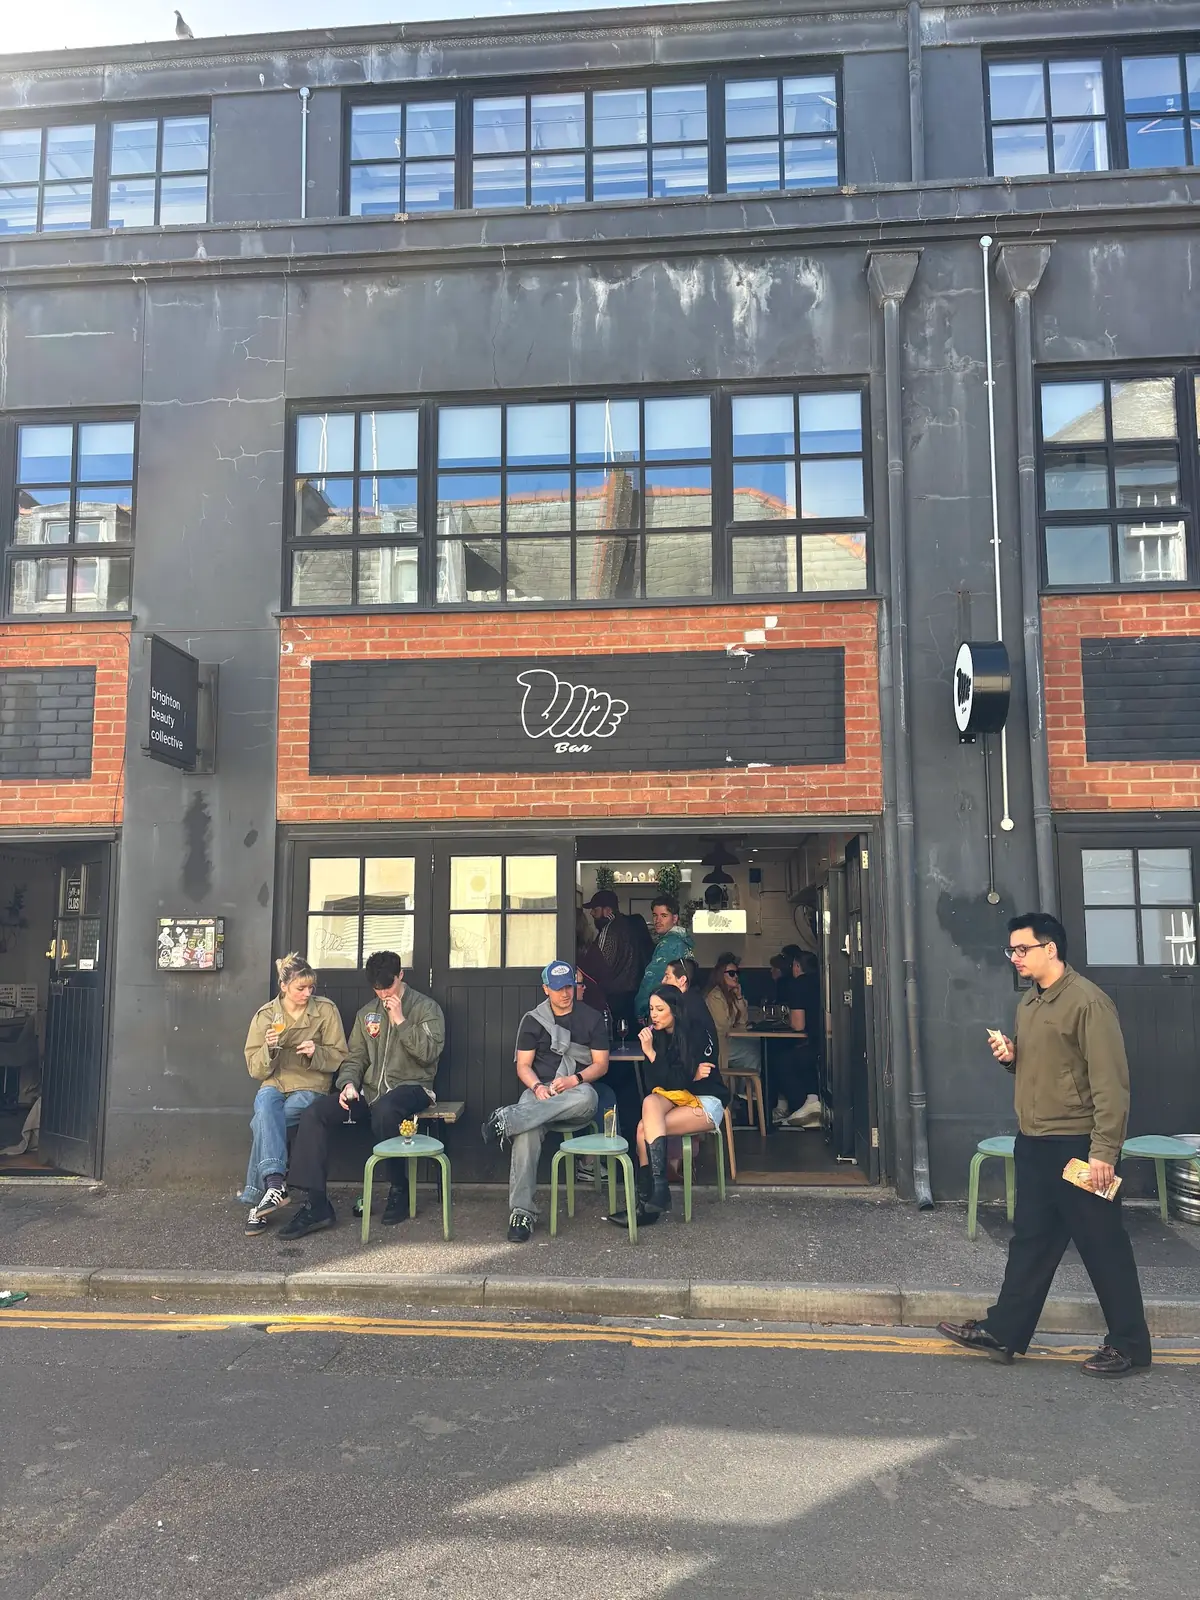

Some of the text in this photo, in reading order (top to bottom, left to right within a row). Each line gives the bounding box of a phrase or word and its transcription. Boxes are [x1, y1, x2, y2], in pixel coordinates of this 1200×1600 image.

[151, 686, 181, 711] brighton
[151, 705, 175, 729] beauty
[150, 729, 184, 750] collective
[553, 741, 593, 754] Bar
